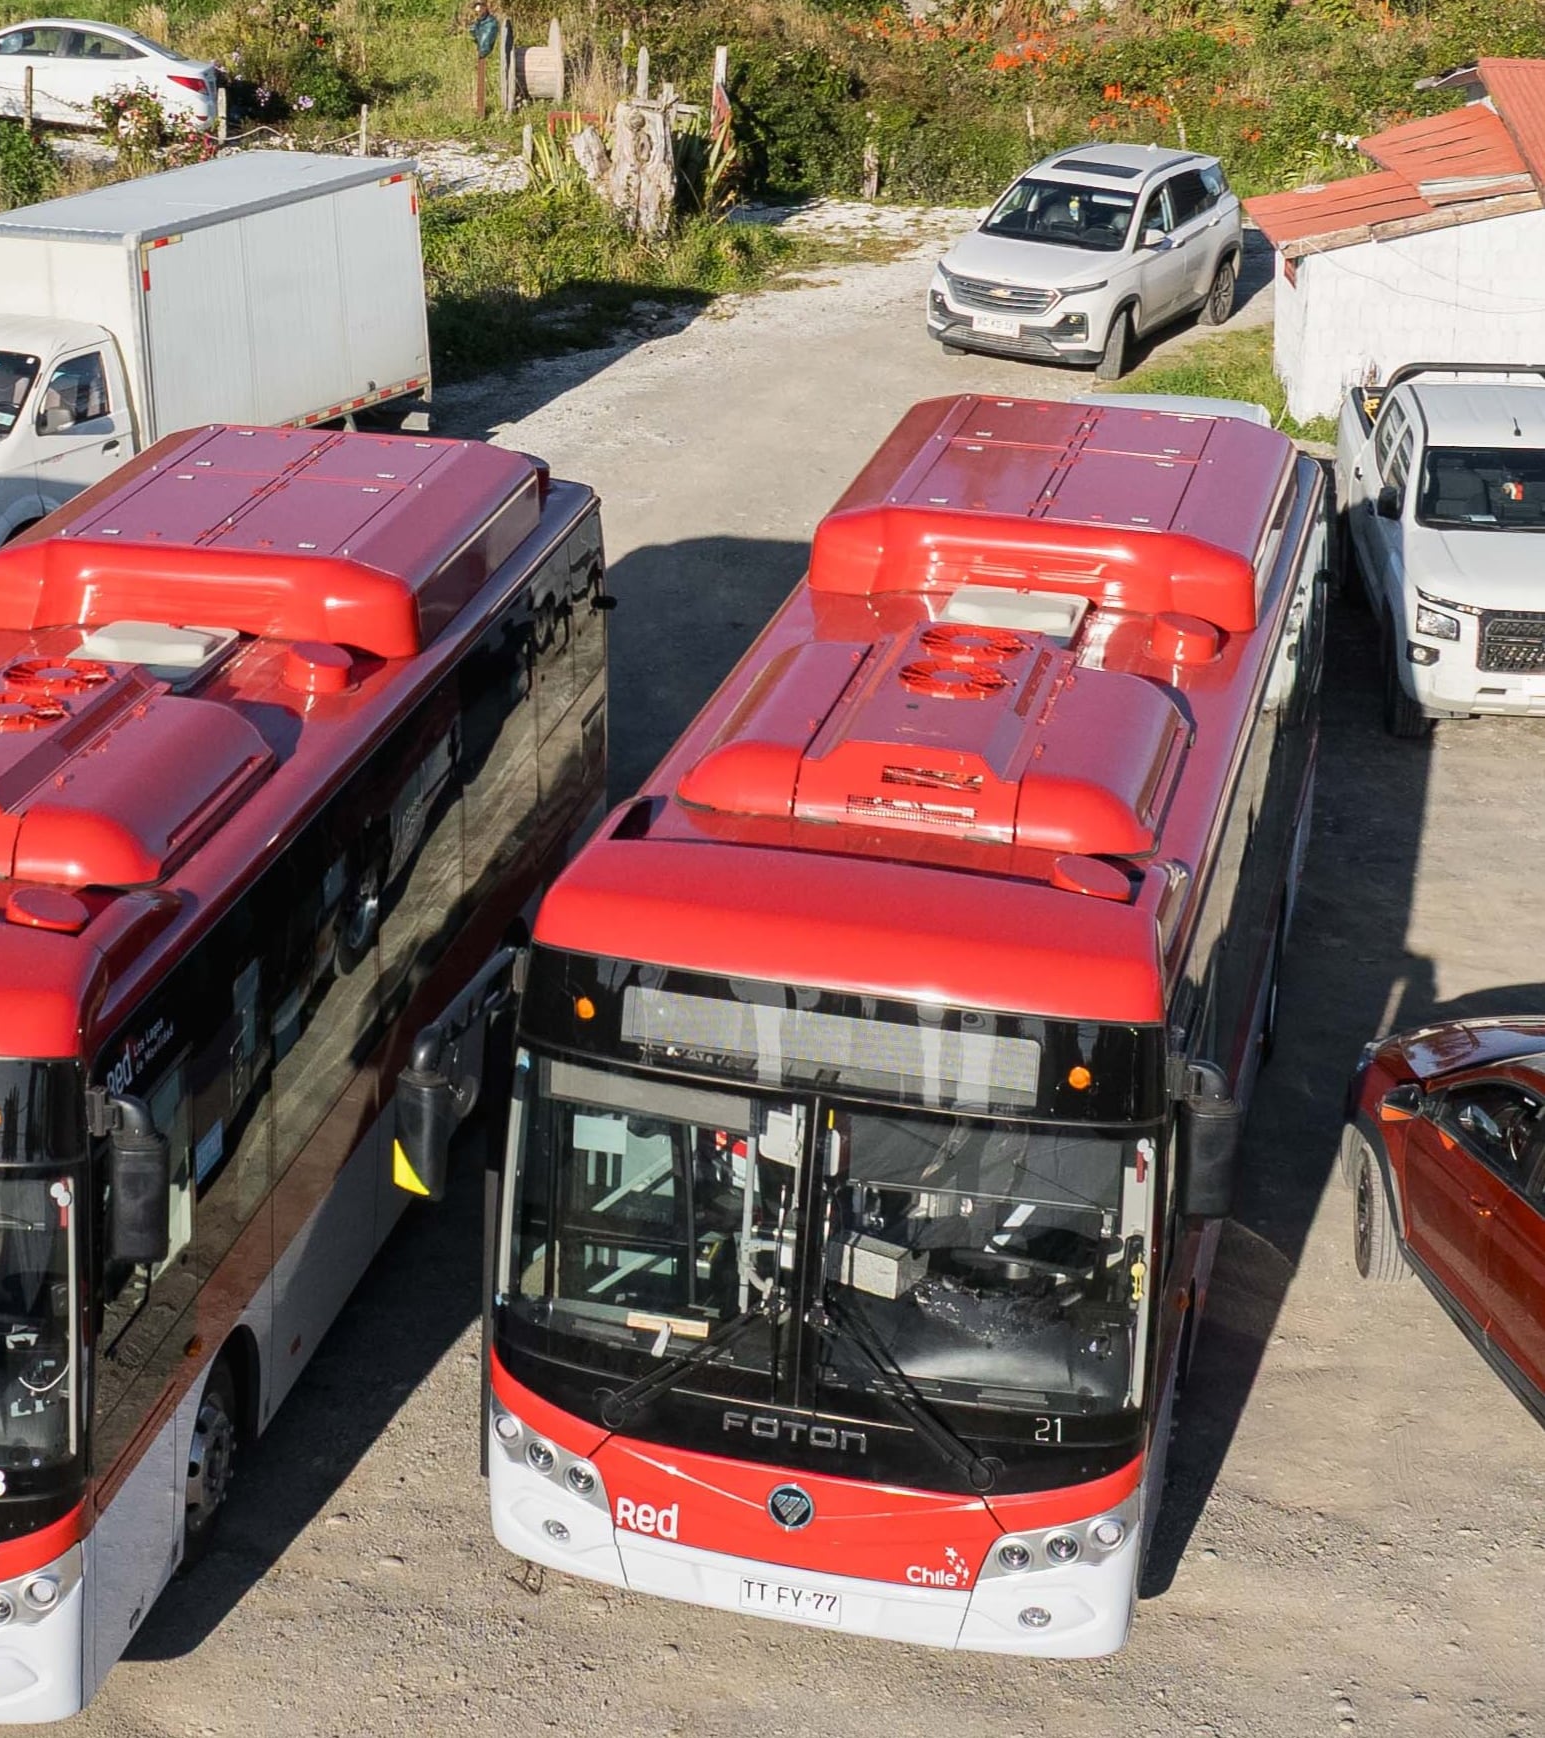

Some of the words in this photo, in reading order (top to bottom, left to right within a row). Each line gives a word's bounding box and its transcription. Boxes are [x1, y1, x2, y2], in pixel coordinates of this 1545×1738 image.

[723, 1411, 866, 1454] FOTON
[1034, 1417, 1062, 1443] 21
[616, 1497, 679, 1540] Red
[906, 1566, 958, 1586] Chile
